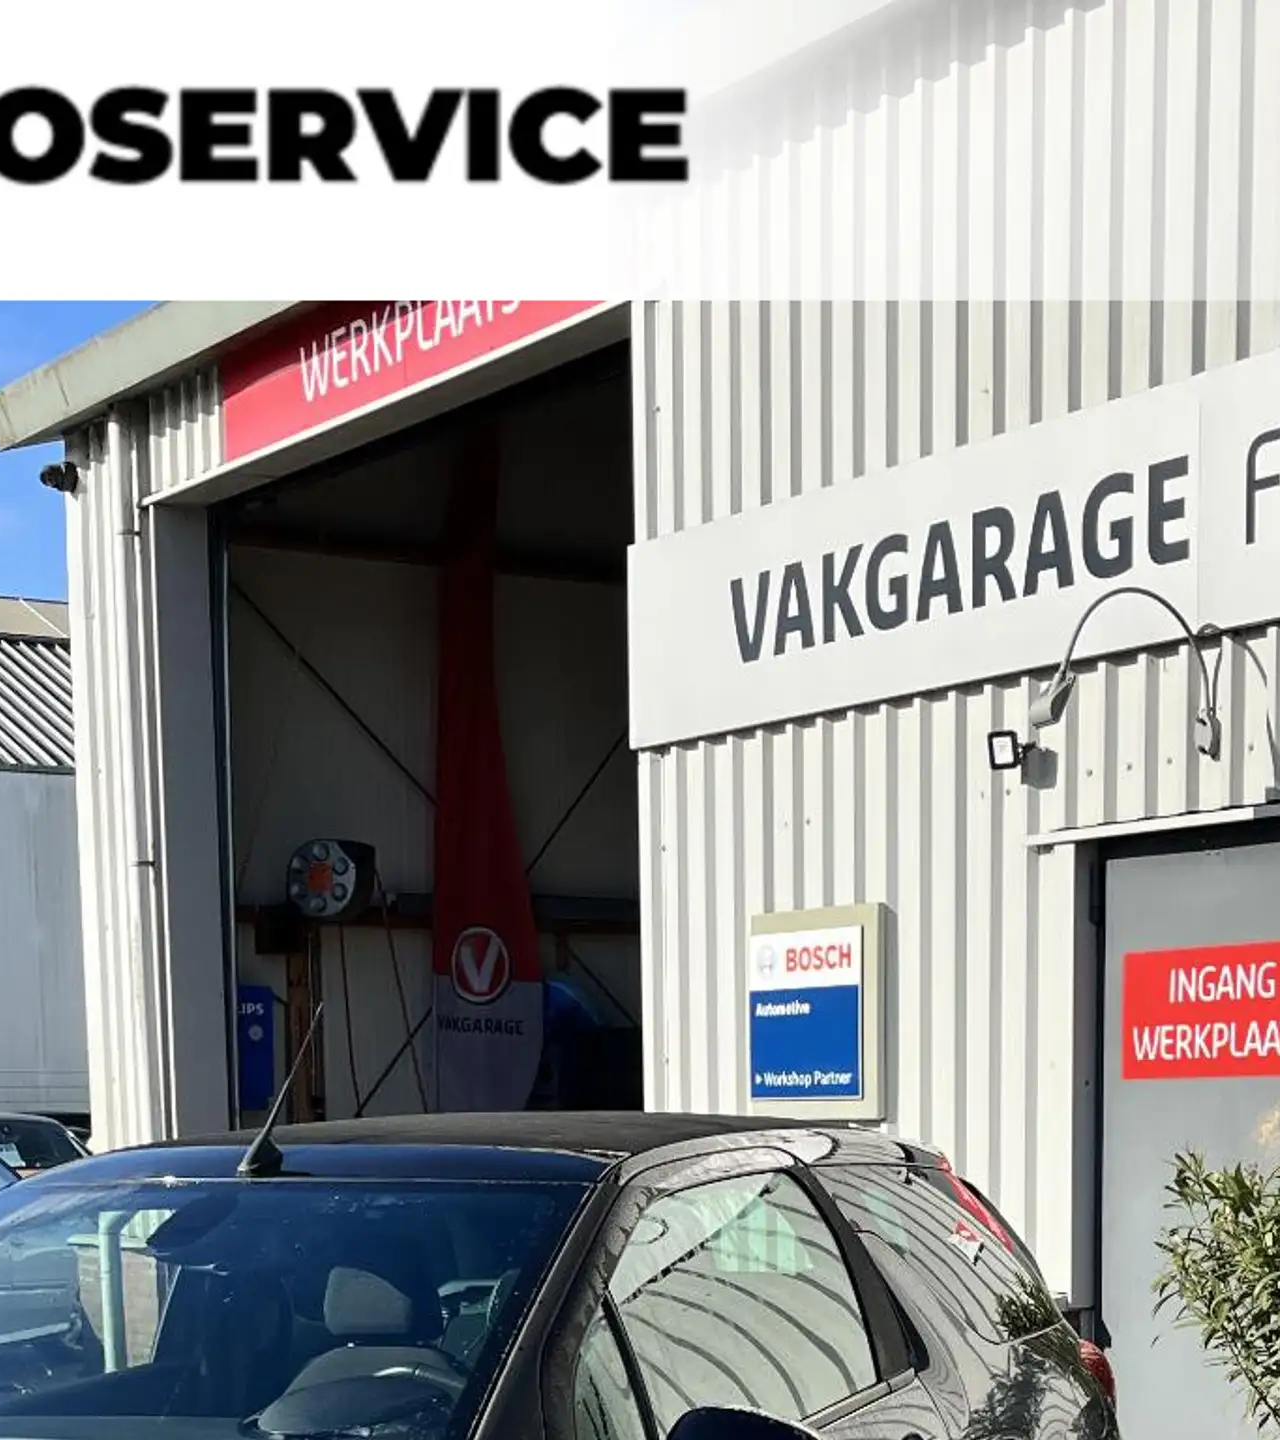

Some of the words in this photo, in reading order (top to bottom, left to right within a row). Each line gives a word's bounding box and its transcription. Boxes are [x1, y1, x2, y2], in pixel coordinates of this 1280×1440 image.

[730, 454, 1190, 664] VAKGARAGE
[785, 943, 853, 973] BOSCH
[1169, 960, 1278, 1004] INGANG
[755, 999, 812, 1018] Automotive
[436, 1014, 525, 1036] VAKGARAGE
[763, 1070, 812, 1088] Workshop
[813, 1069, 853, 1086] Partner
